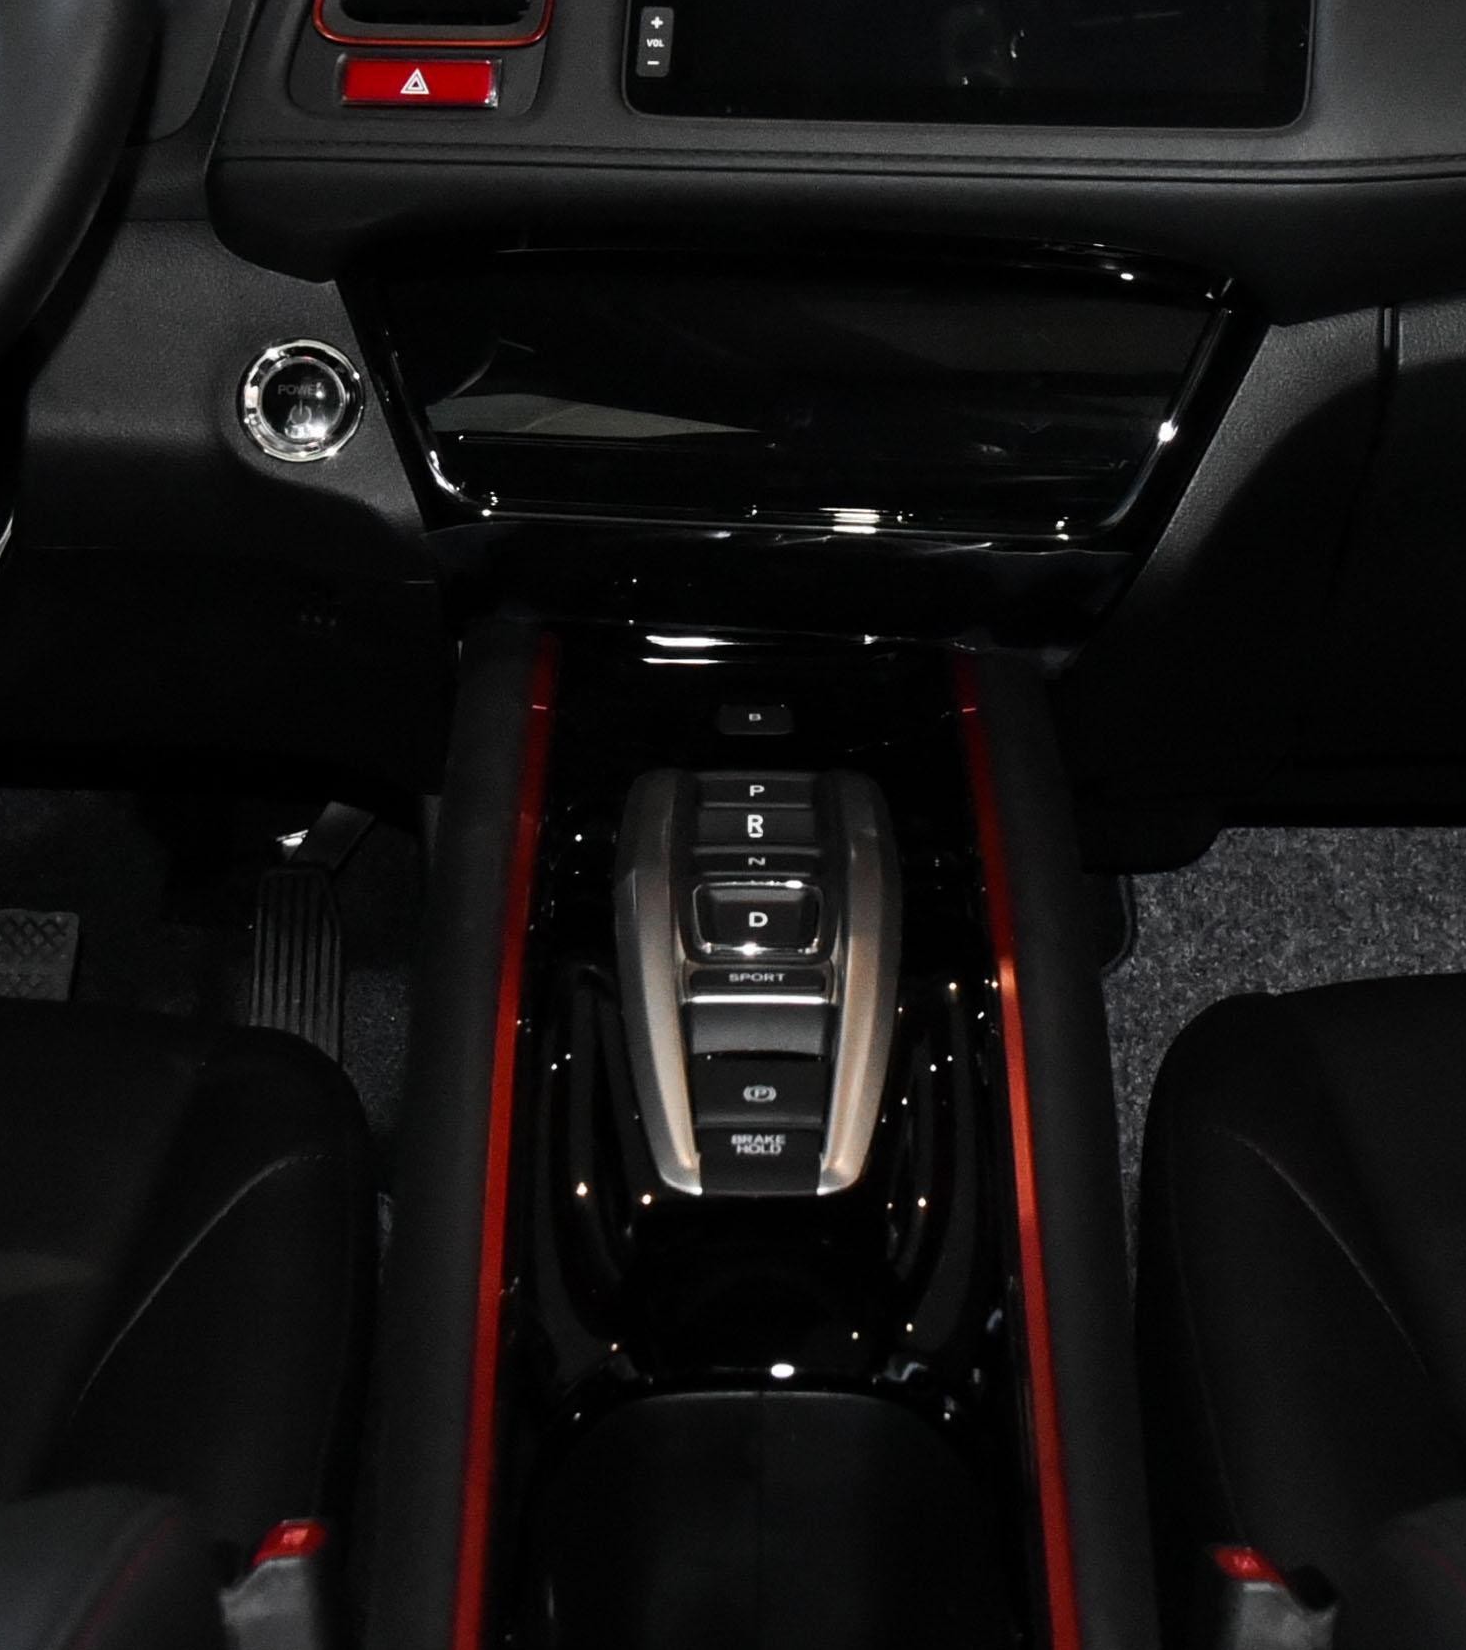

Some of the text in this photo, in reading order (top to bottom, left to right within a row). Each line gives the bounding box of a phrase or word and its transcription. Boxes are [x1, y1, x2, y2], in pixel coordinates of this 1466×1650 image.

[646, 38, 666, 48] VOL
[749, 784, 765, 797] P
[746, 813, 764, 838] R
[747, 857, 766, 866] N
[748, 911, 769, 928] D
[729, 972, 786, 982] SPORT
[731, 1134, 786, 1145] BRAKE
[736, 1144, 782, 1155] HOLD
